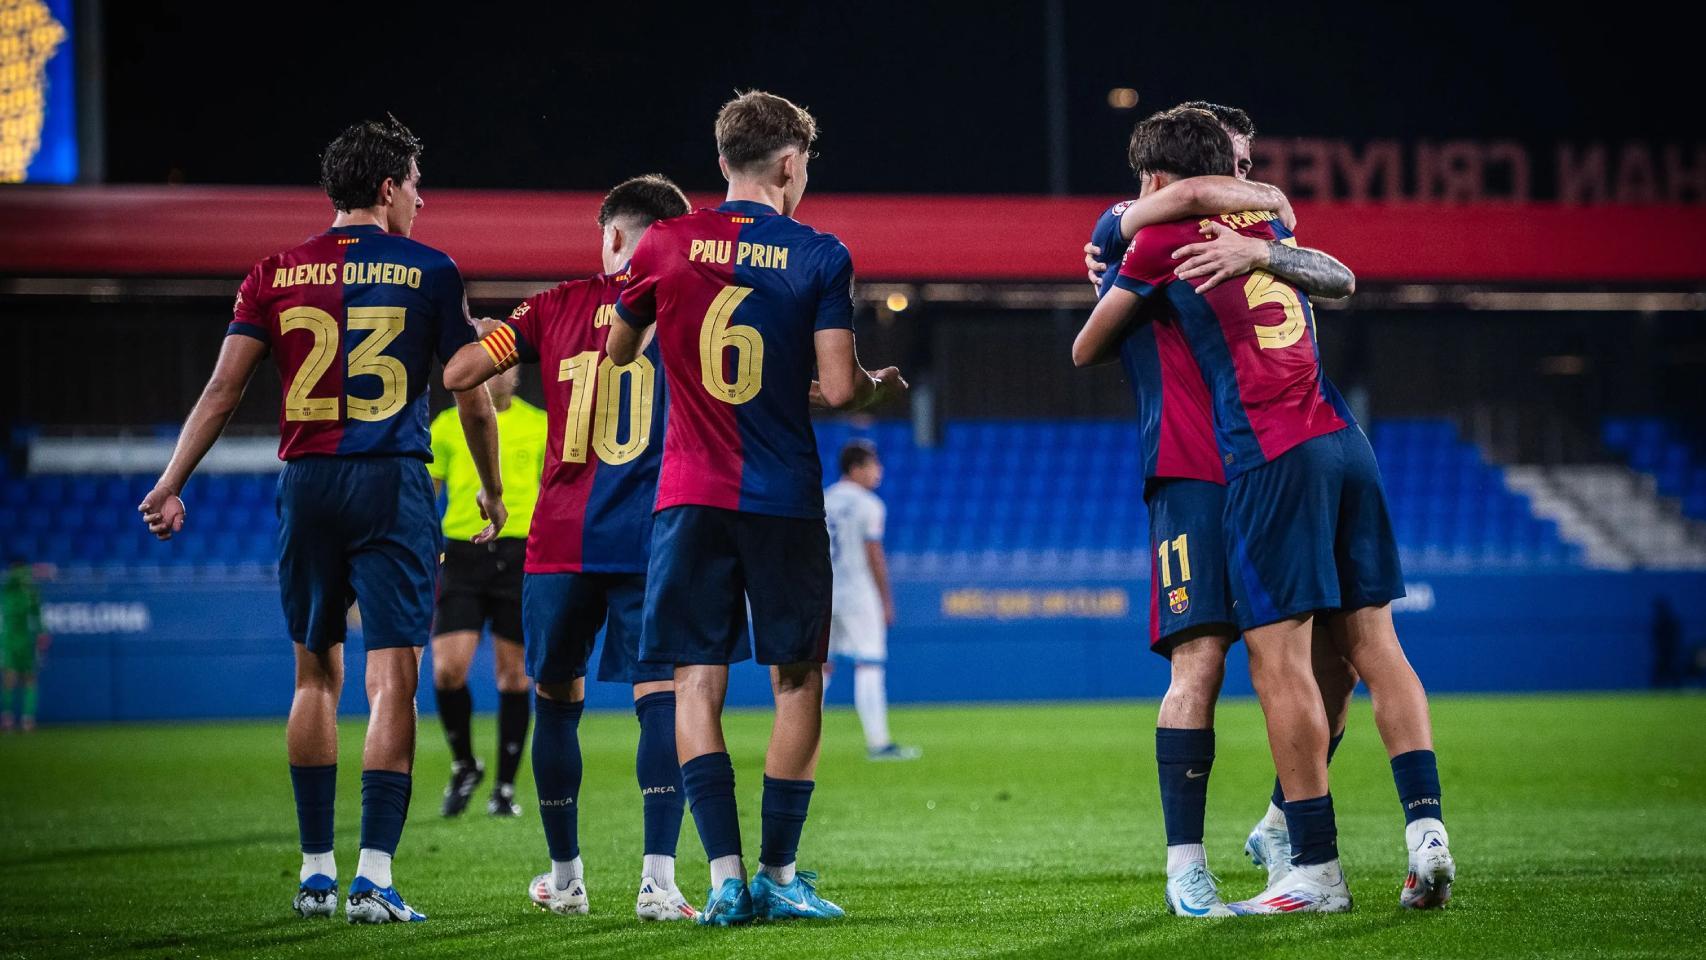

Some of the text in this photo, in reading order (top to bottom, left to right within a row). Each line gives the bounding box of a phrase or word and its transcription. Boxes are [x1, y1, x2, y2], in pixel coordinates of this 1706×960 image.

[272, 262, 422, 289] ALEXIS OLMEDO
[689, 240, 789, 269] PAU PRIM
[280, 306, 407, 422] 23
[699, 285, 764, 404] 6
[558, 350, 655, 465] 10
[1159, 534, 1191, 588] 11
